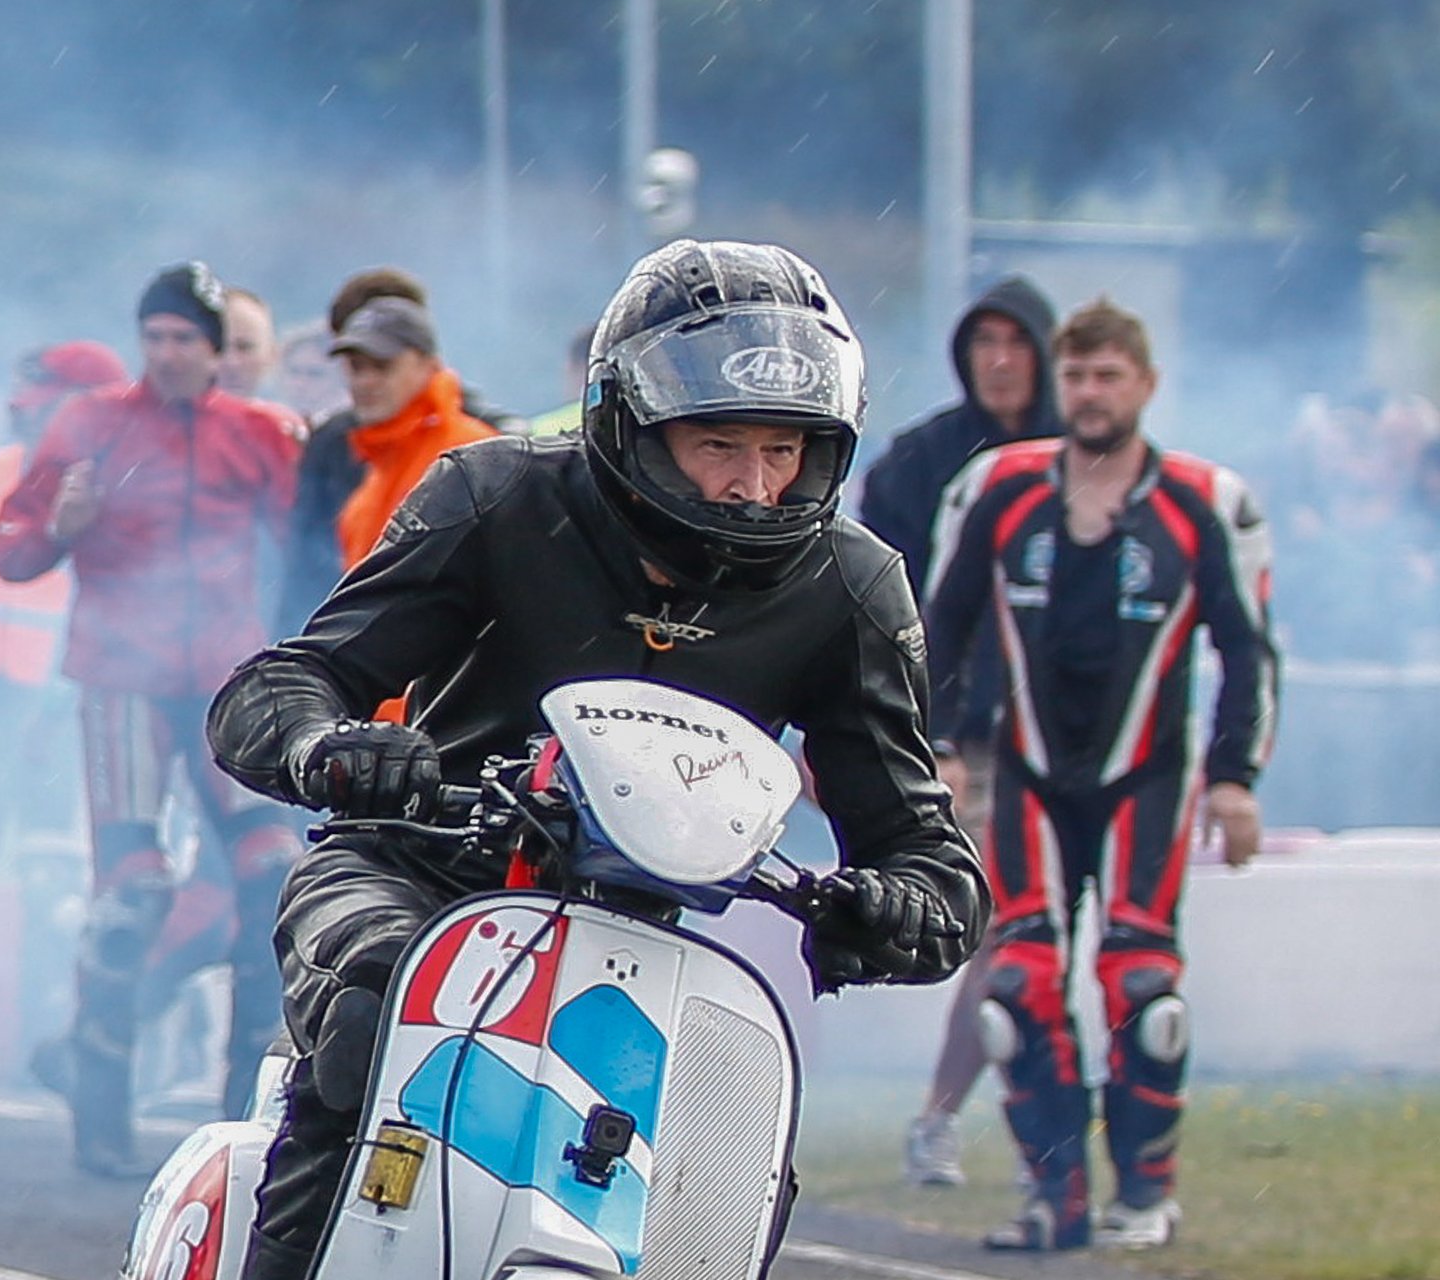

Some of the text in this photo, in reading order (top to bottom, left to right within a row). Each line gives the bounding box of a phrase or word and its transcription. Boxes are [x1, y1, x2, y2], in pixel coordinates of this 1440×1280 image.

[575, 704, 729, 745] hornet
[673, 750, 750, 792] Racing
[433, 906, 556, 1029] 6
